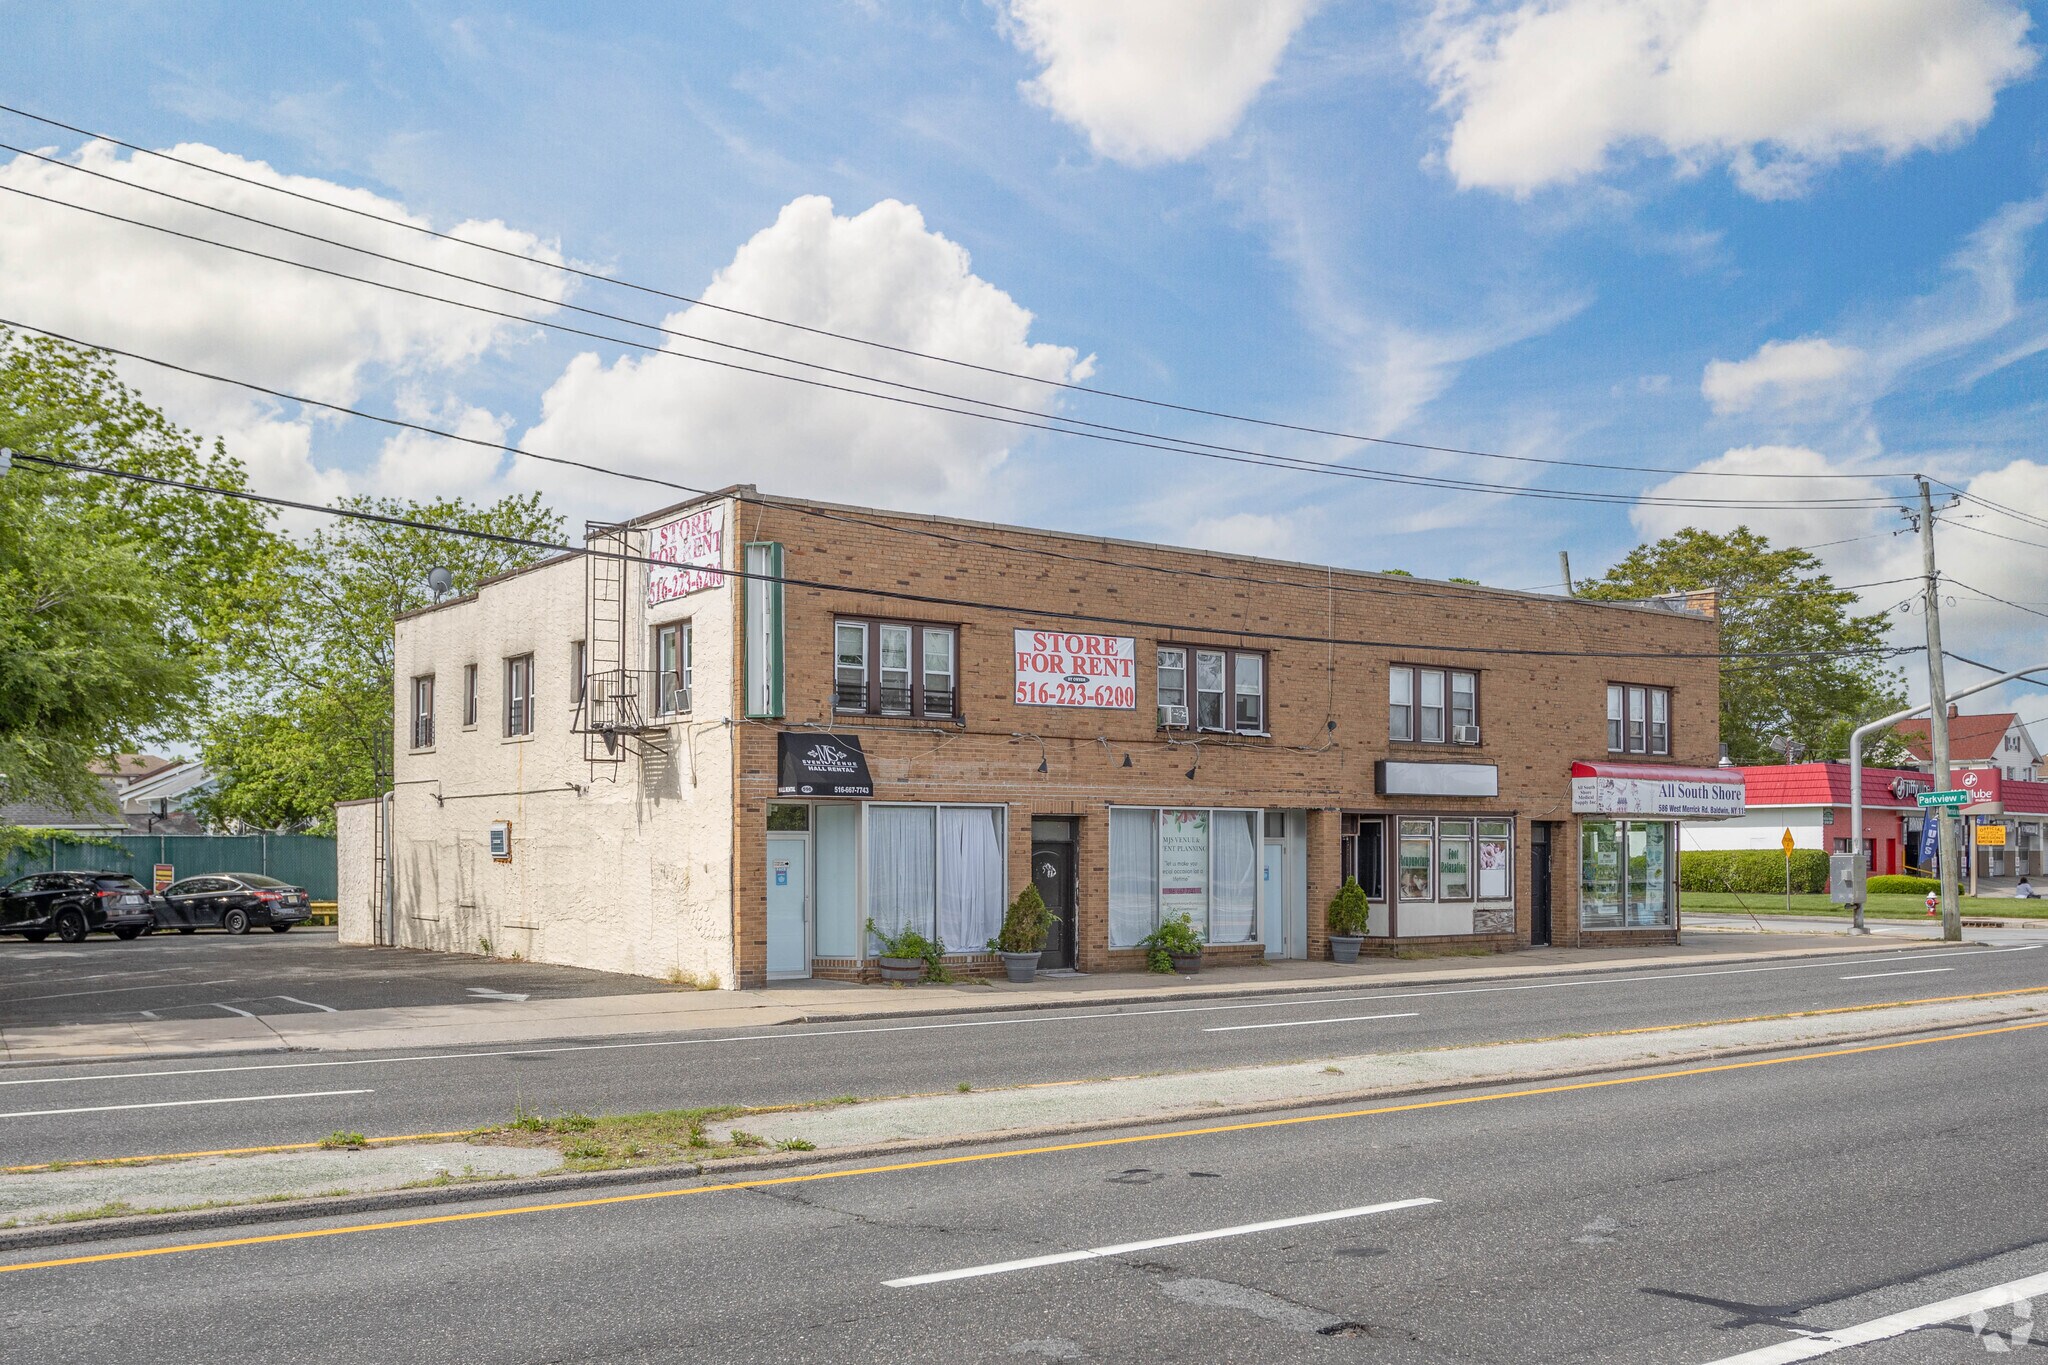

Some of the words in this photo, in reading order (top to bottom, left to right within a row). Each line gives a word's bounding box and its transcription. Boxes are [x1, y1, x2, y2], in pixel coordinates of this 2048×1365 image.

[660, 511, 713, 548] STORE
[1033, 632, 1118, 657] STORE
[1017, 652, 1066, 674] FOR
[1071, 655, 1134, 678] RENT
[1016, 681, 1134, 708] 516-223-6200
[834, 786, 870, 794] 516-667-7743
[1658, 783, 1675, 798] All
[1677, 783, 1709, 799] South
[1711, 785, 1742, 801] Shore
[1919, 795, 1957, 804] Parkview
[1658, 804, 1668, 812] 586
[1669, 804, 1681, 813] West
[1682, 805, 1700, 813] Merrick
